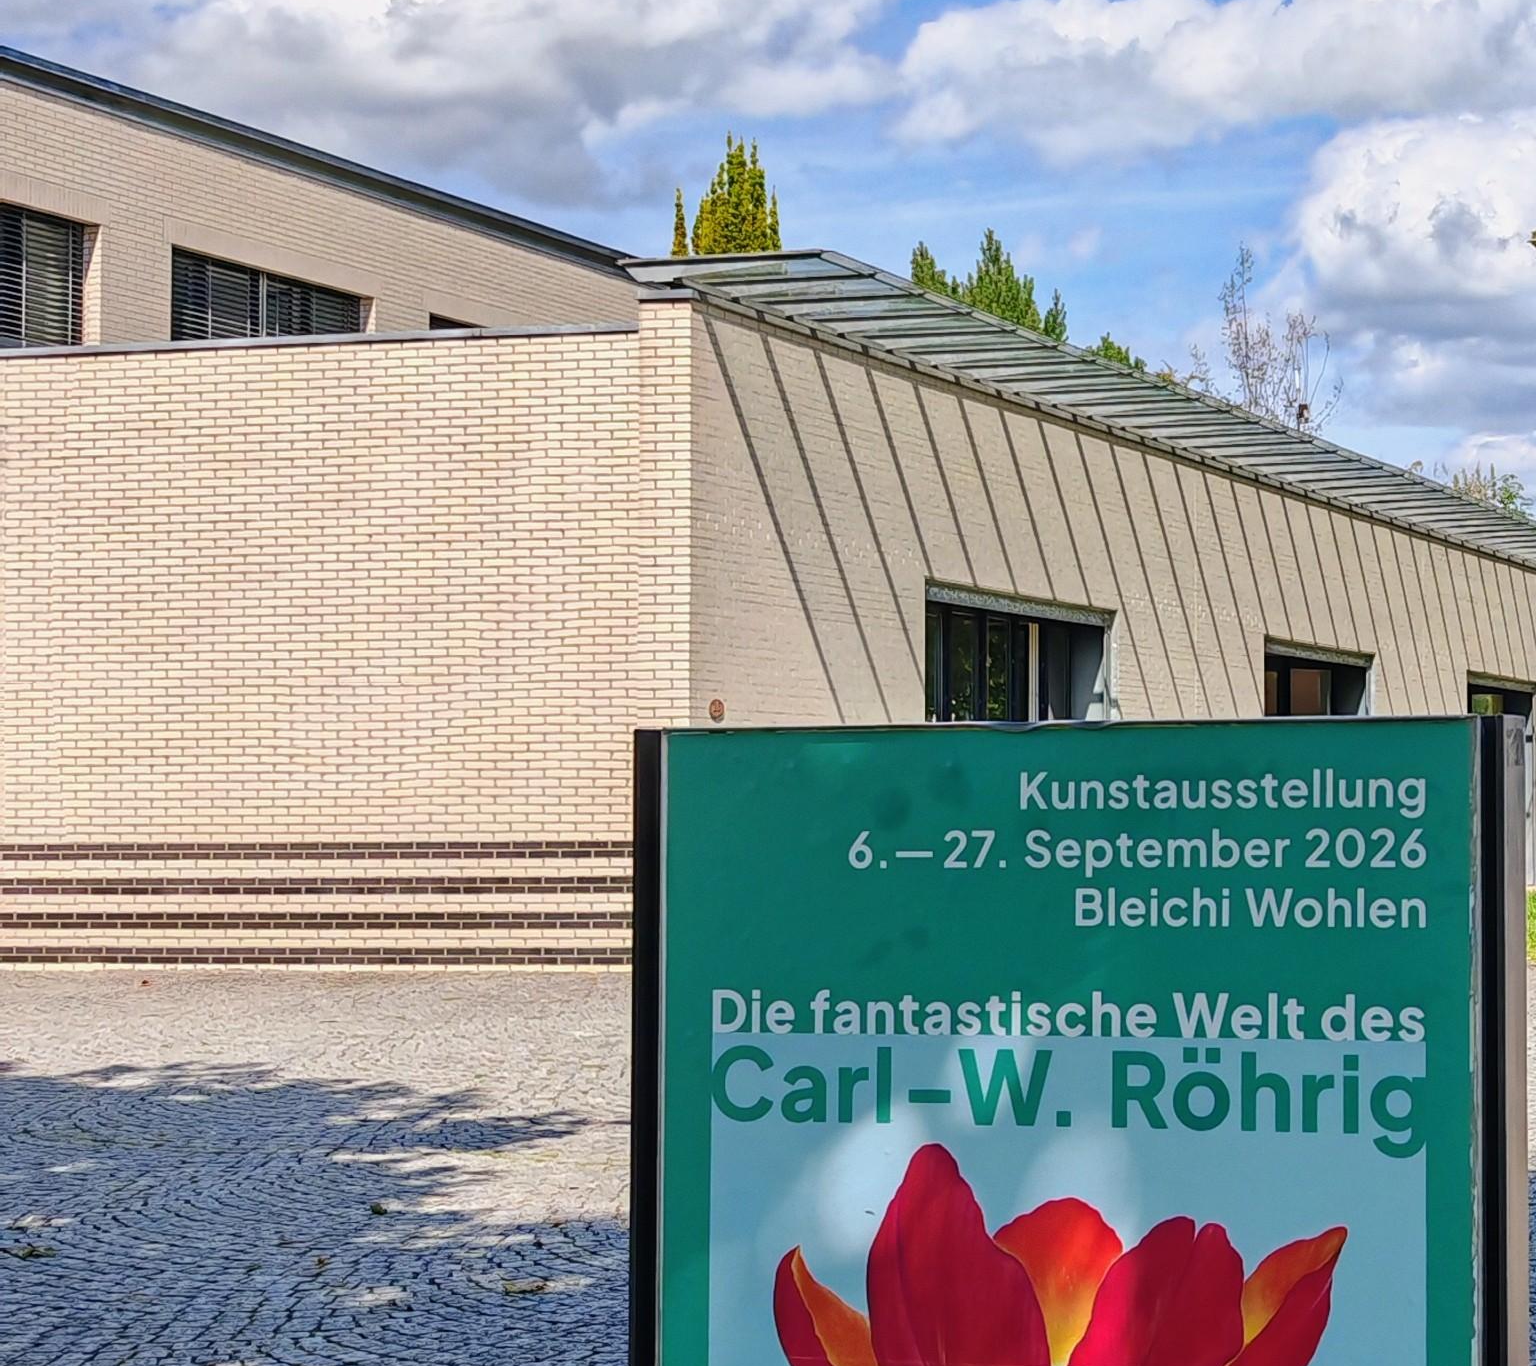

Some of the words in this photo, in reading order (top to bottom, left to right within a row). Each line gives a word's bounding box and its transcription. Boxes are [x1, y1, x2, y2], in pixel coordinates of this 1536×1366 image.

[1019, 768, 1427, 819] Kunstausstellung
[1023, 828, 1291, 879] September
[1304, 828, 1428, 870] 2026
[1074, 886, 1231, 928] Bleichi
[1244, 886, 1428, 929] Wohlen
[712, 988, 796, 1035] Die
[810, 988, 1158, 1038] fantastische
[1172, 991, 1306, 1041] Welt
[1320, 993, 1426, 1043] des
[1111, 1046, 1427, 1159] Röhrig
